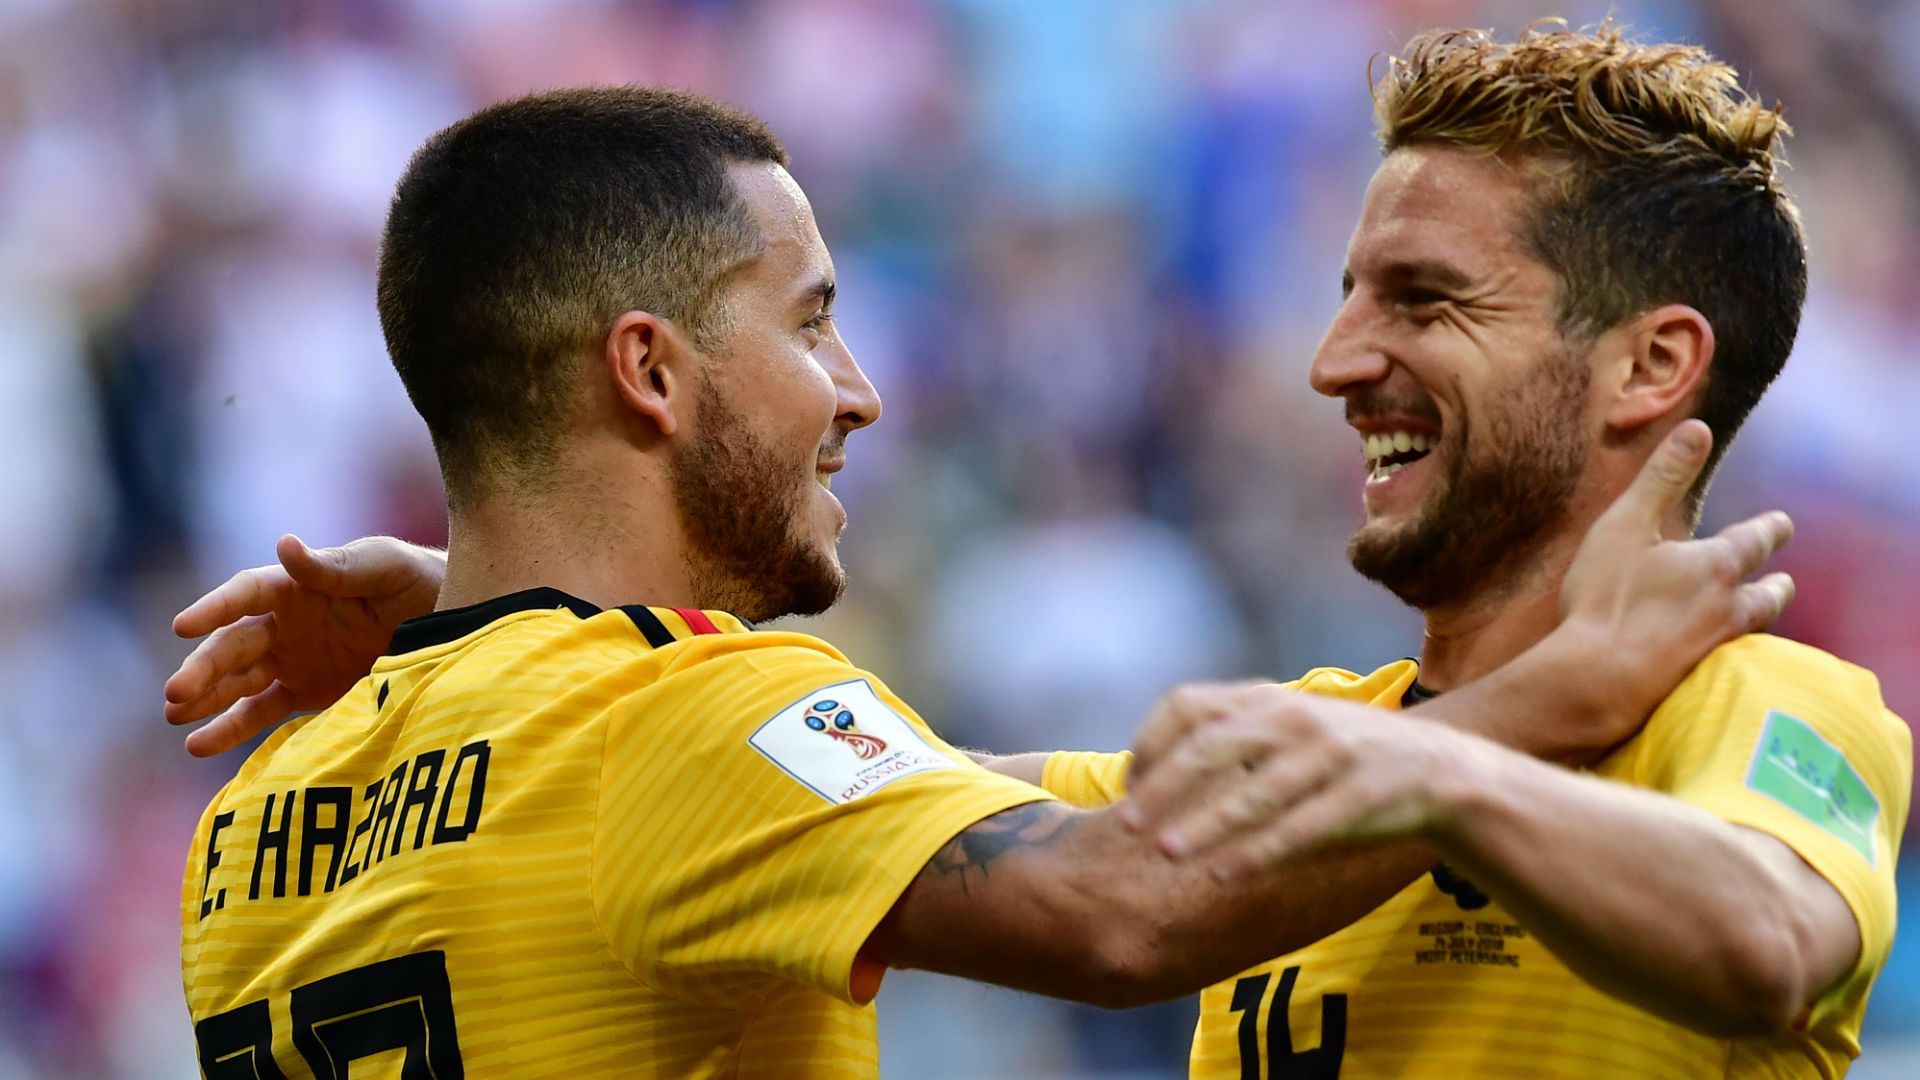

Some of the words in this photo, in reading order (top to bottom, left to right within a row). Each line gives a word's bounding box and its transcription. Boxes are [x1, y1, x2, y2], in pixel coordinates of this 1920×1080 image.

[200, 810, 236, 921] E.
[248, 739, 491, 900] HAZARD
[841, 760, 910, 800] RUSSIA
